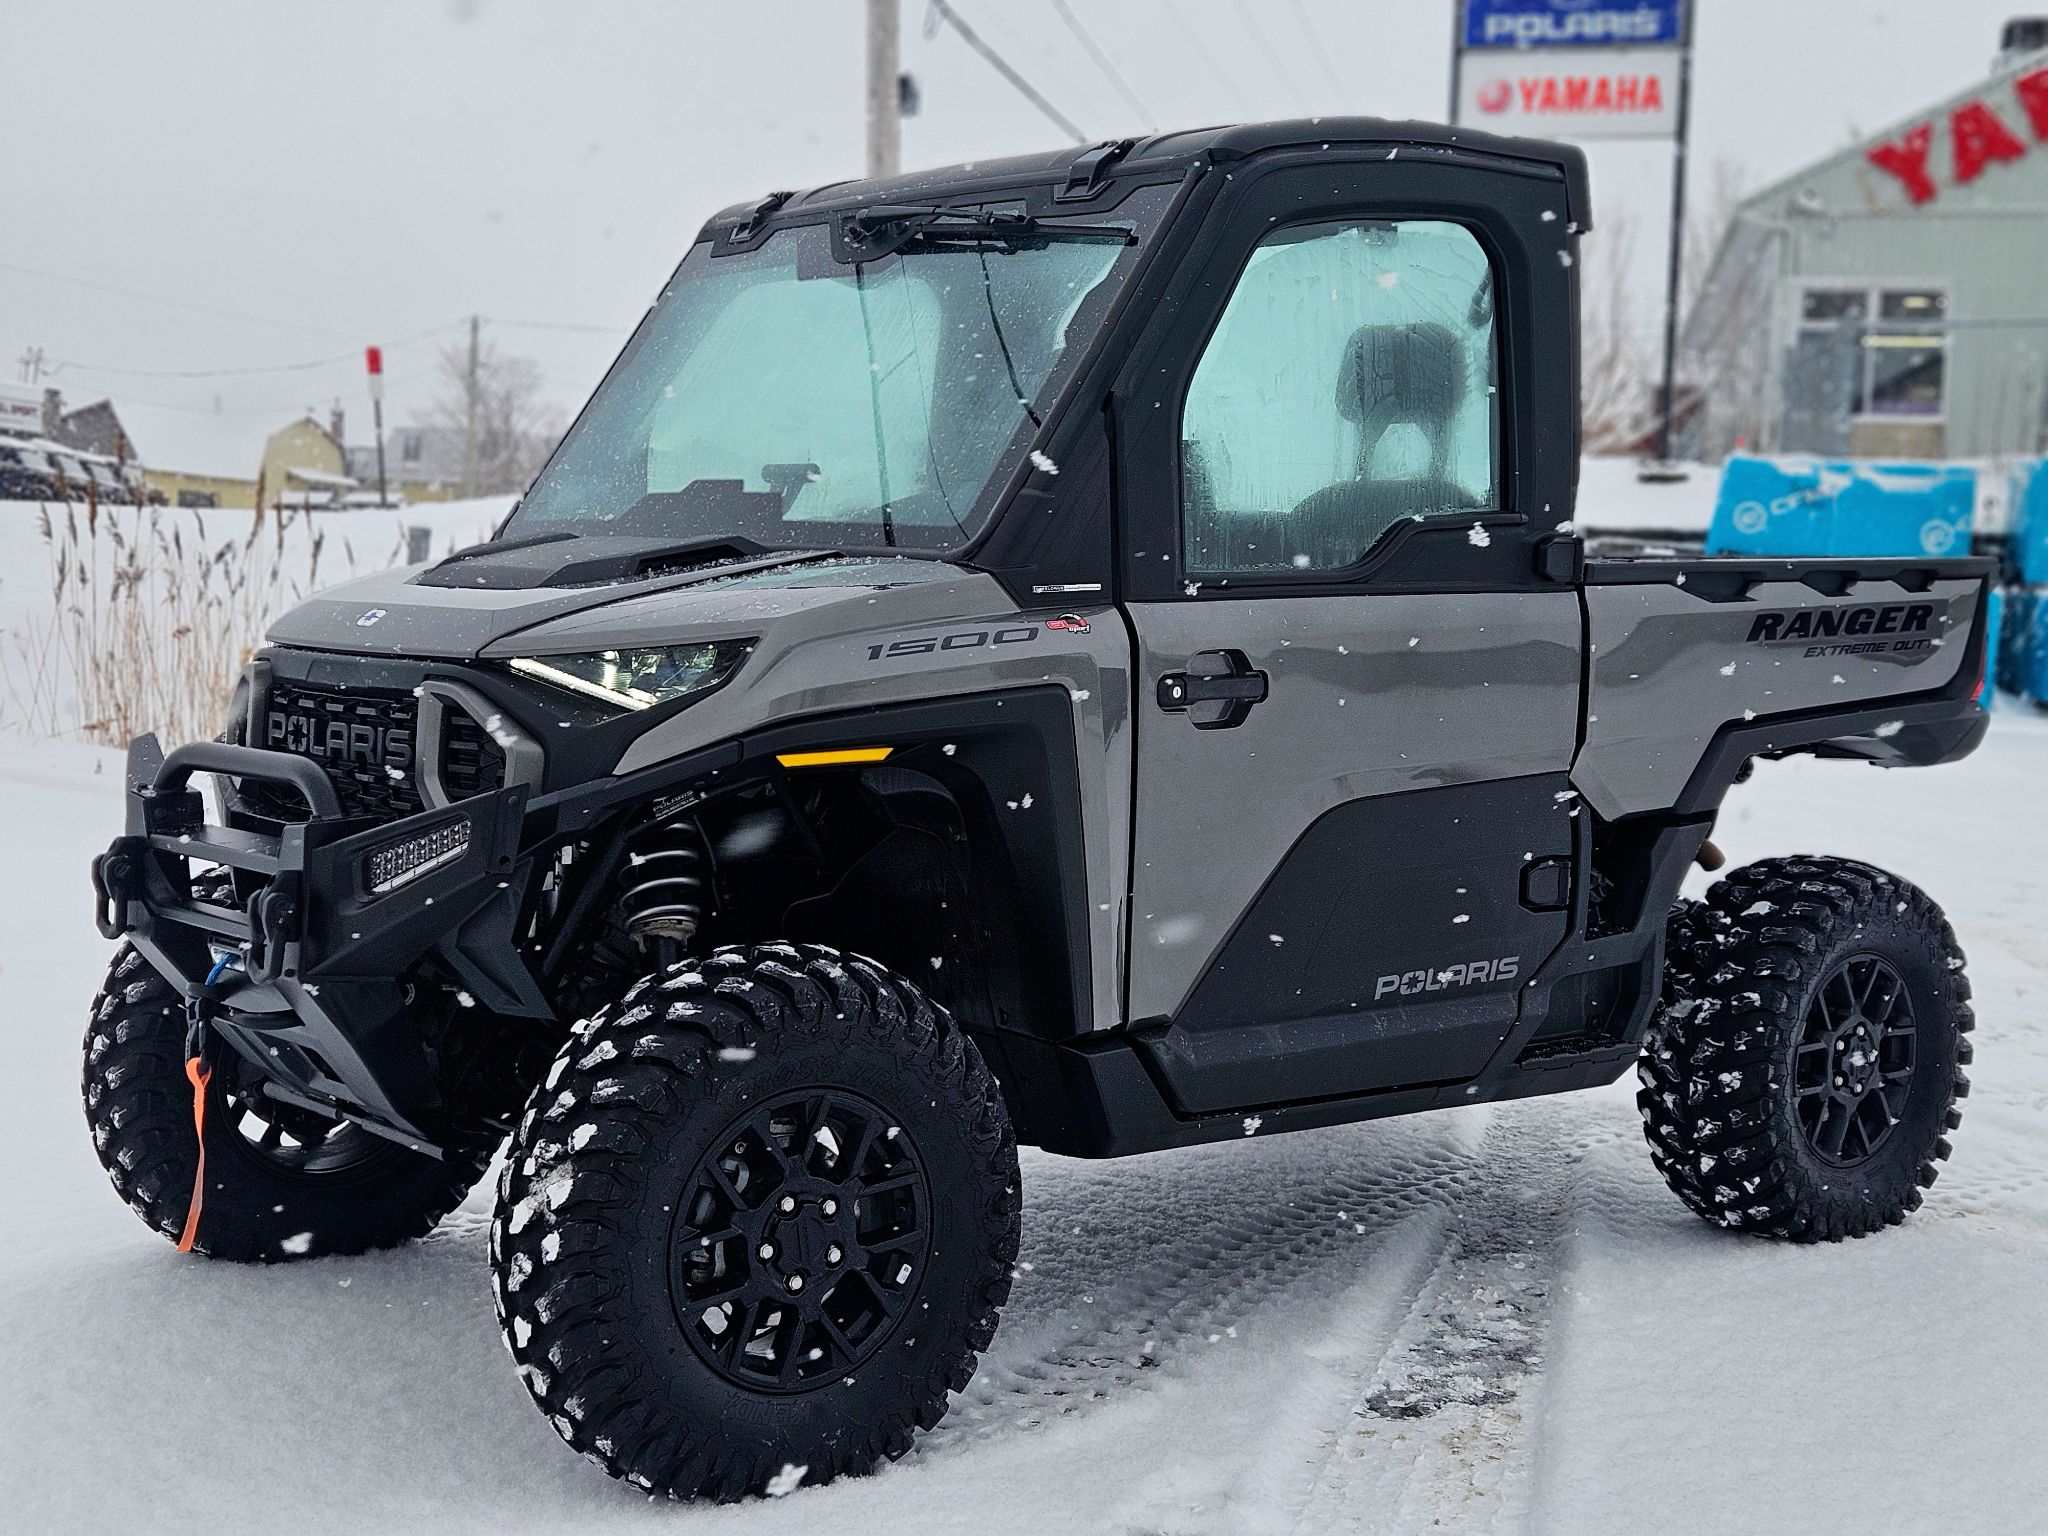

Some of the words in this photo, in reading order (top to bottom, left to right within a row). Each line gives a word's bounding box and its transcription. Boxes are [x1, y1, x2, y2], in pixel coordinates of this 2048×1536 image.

[1485, 12, 1661, 40] POLARIS
[1519, 75, 1662, 113] YAMAHA
[1745, 604, 1934, 643] RANGER
[867, 627, 1039, 661] 1500
[1803, 641, 1889, 659] EXTREME
[267, 711, 413, 768] POLARIS
[1374, 956, 1520, 1000] POLARIS
